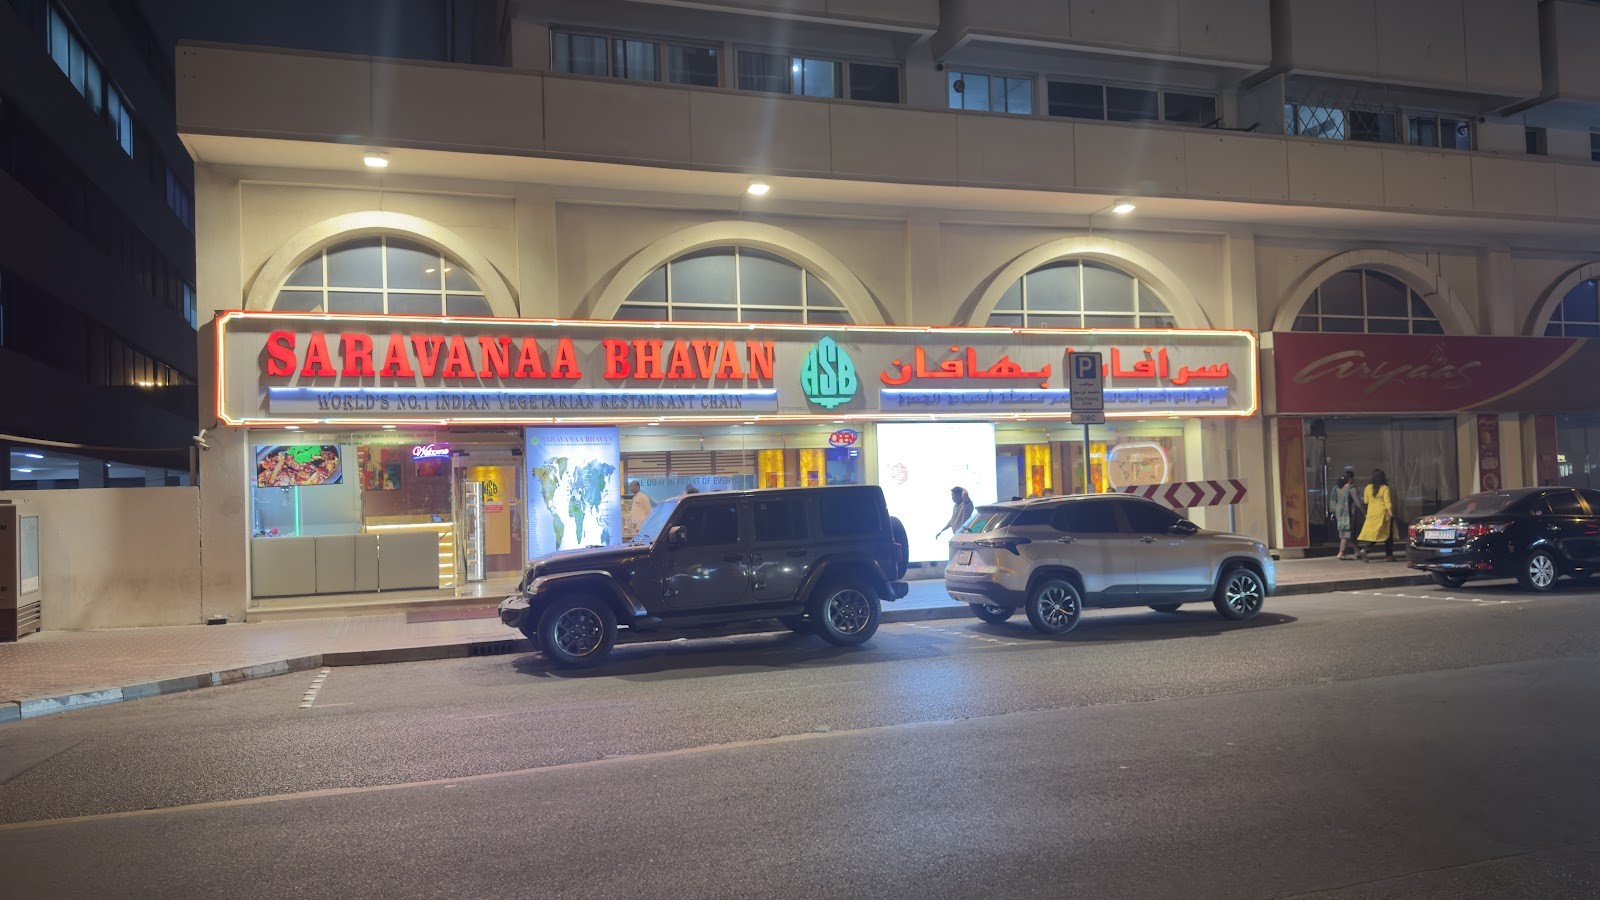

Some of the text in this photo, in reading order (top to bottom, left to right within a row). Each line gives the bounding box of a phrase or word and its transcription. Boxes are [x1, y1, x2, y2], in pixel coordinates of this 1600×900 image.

[267, 331, 776, 381] SARAVANAA BHAVAN
[880, 344, 1052, 389] بهافان
[1078, 356, 1092, 378] P
[317, 391, 743, 411] WORLD'S NO.1 INDIAN VEGETARIAN RESTAURANT CHAIN
[831, 432, 855, 444] OPEN
[646, 479, 657, 487] DO
[702, 477, 711, 485] OF
